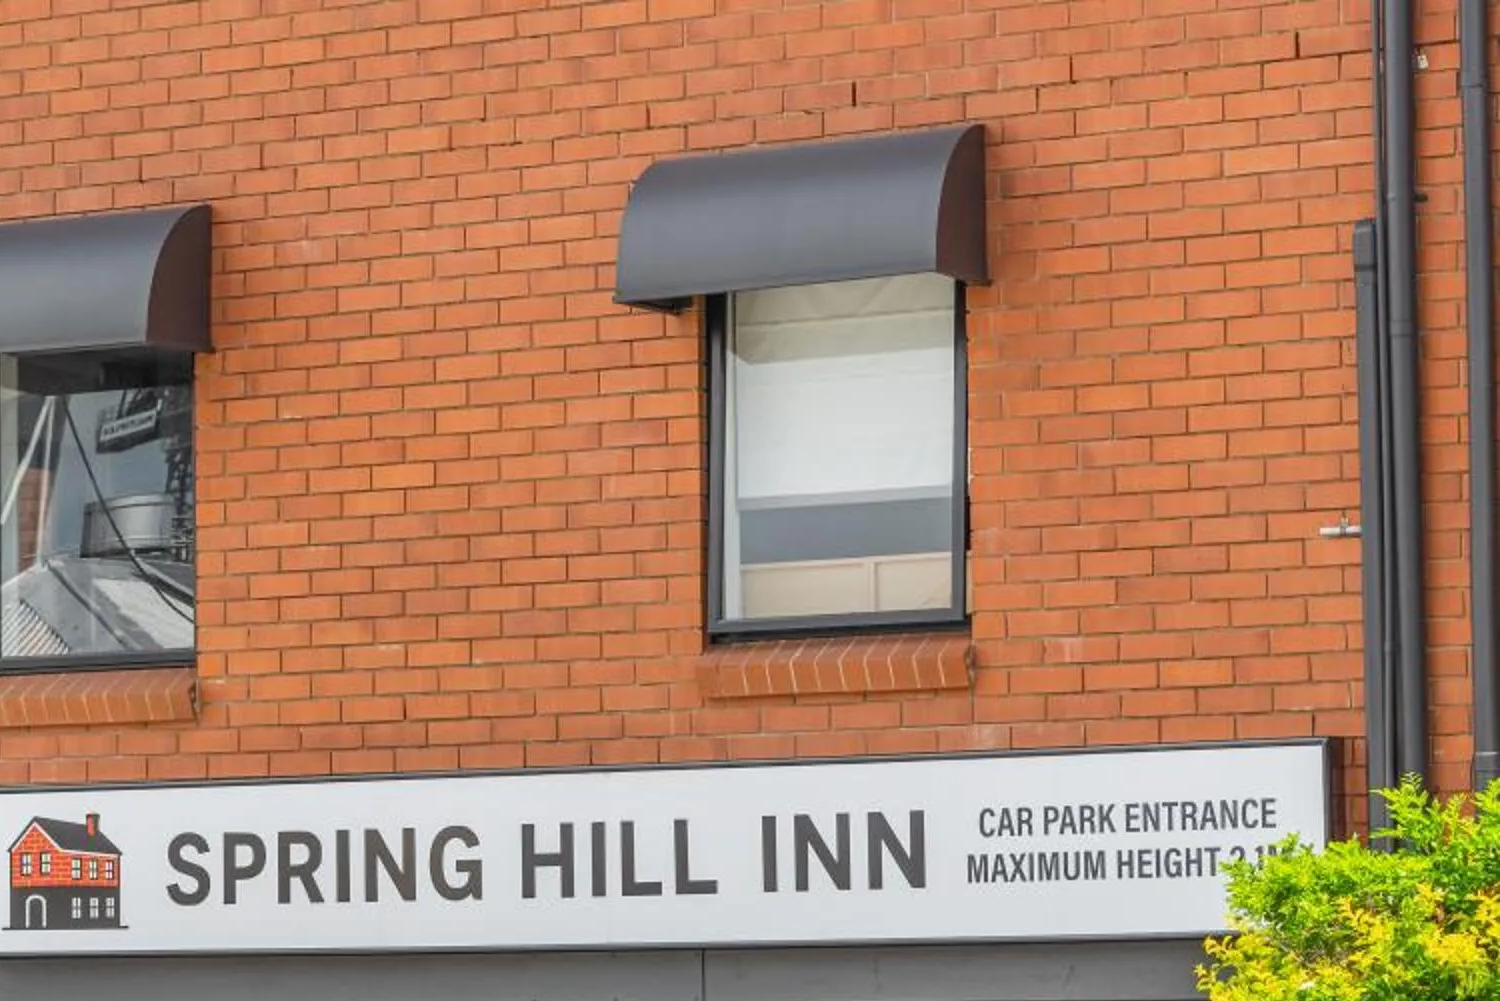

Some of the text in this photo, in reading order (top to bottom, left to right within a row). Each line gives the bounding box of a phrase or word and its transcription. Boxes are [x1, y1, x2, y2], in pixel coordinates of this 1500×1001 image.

[979, 798, 1277, 838] CAR PARK ENTRANCE
[166, 810, 927, 907] SPRING HILL INN
[967, 850, 1106, 884] MAXIMUM
[1116, 846, 1221, 879] HEIGHT
